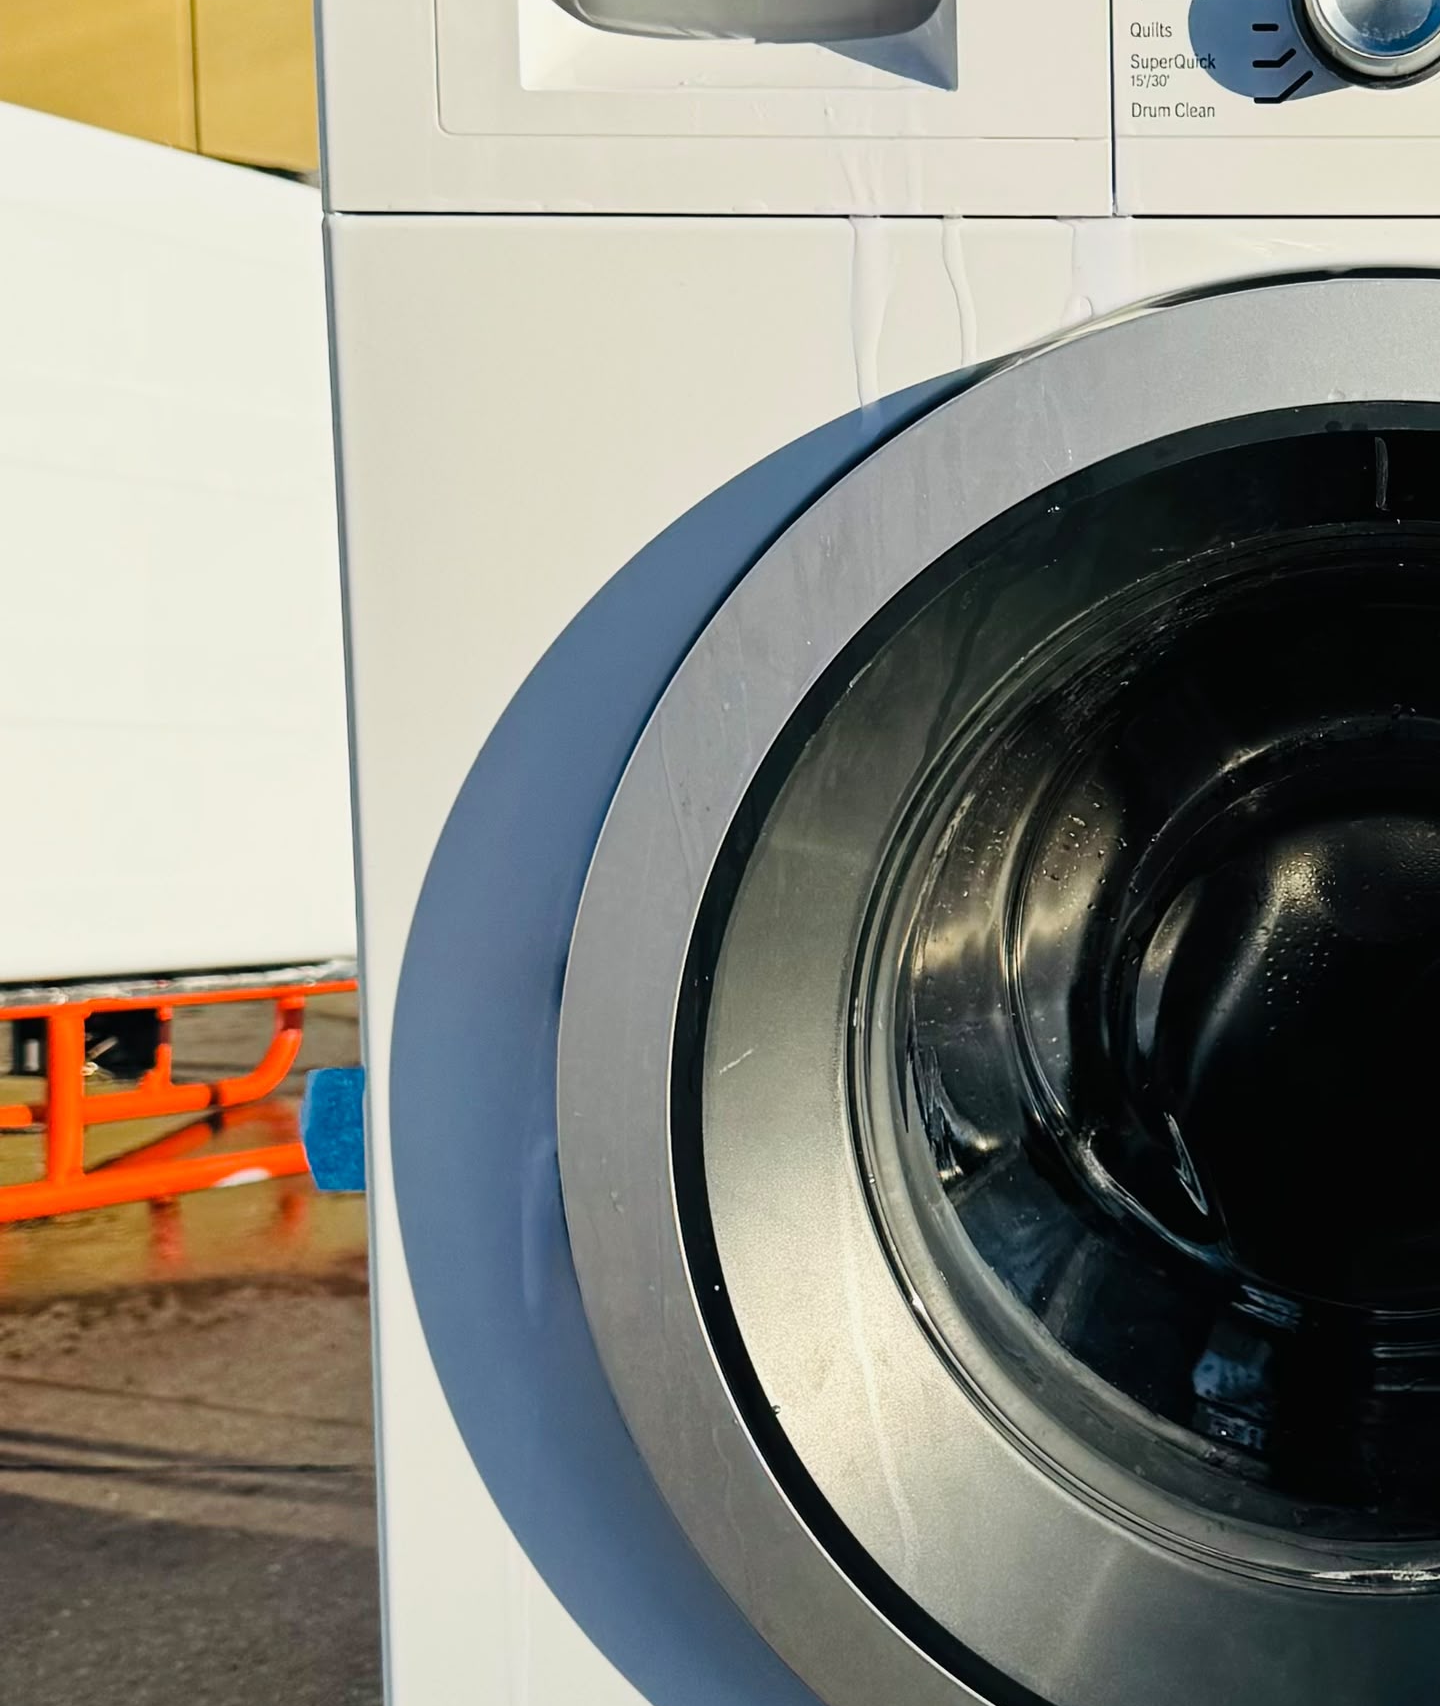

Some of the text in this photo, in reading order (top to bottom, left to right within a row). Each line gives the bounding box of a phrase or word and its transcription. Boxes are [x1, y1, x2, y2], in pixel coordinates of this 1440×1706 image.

[1130, 23, 1172, 39] Quilts
[1131, 54, 1216, 71] SuperQuick
[1131, 103, 1215, 117] Drum Clean
